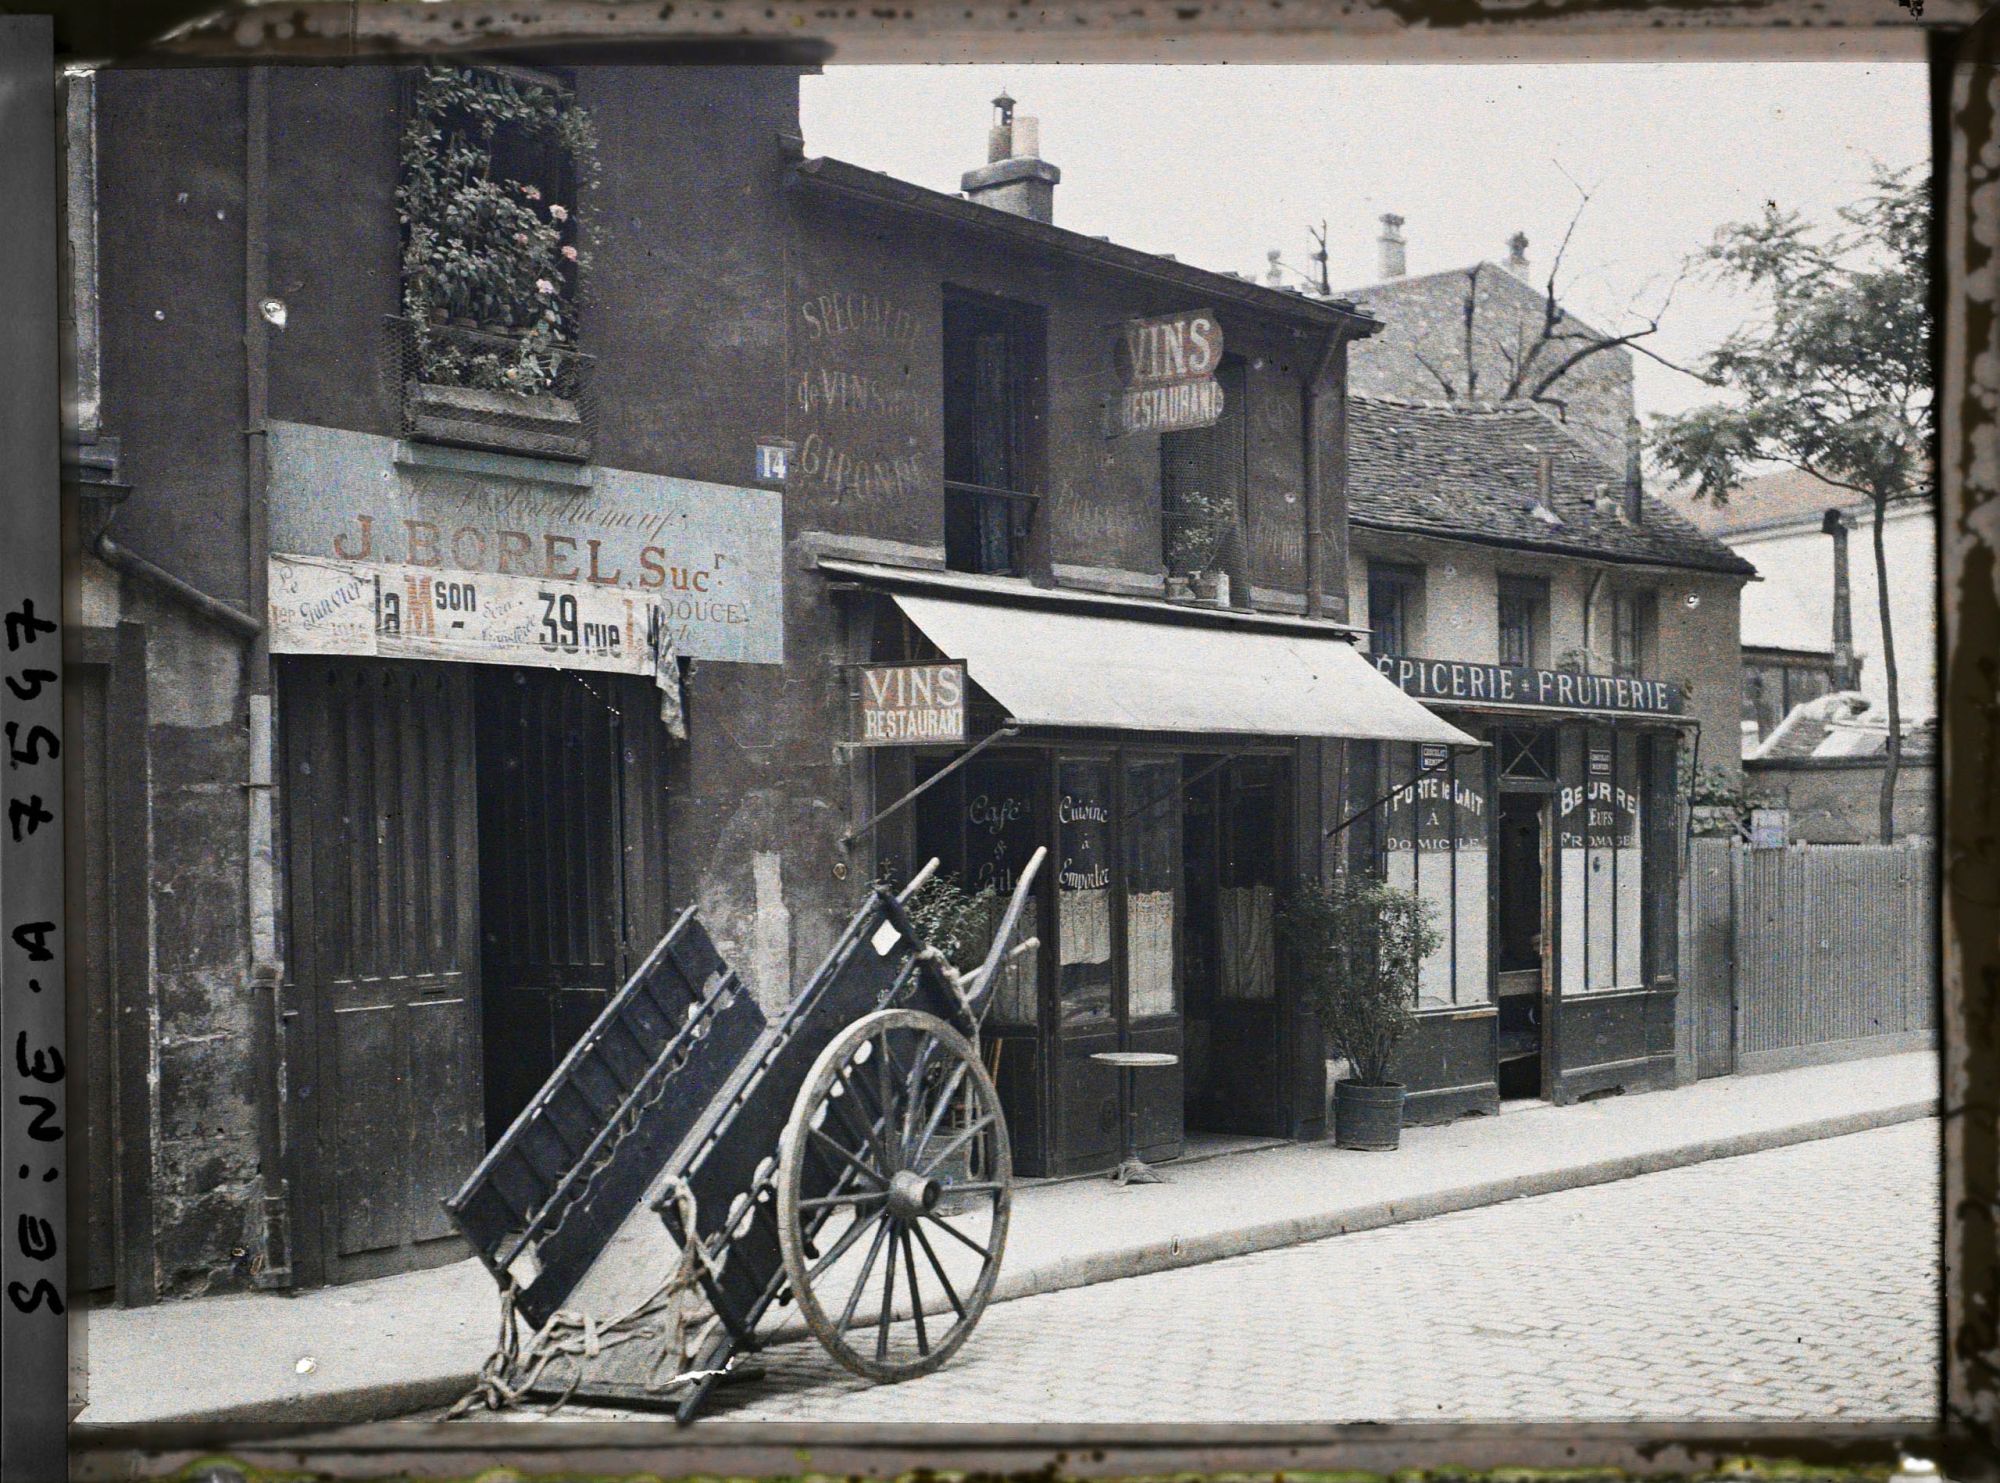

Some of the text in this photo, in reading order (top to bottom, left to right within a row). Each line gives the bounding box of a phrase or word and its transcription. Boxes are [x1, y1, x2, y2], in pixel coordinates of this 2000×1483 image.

[1127, 319, 1210, 377] VINS
[763, 447, 786, 478] 14
[538, 591, 578, 654] 39
[584, 622, 622, 658] rue
[865, 667, 960, 707] VINS
[1376, 654, 1669, 710] ÉPICERIE FRUITERIE
[865, 708, 963, 738] RESTAURANT
[969, 794, 1022, 835] Café
[1059, 795, 1109, 824] Cuisine
[1454, 779, 1484, 816] LAIT
[1560, 781, 1636, 818] BEURRE
[1059, 857, 1110, 892] Emporter
